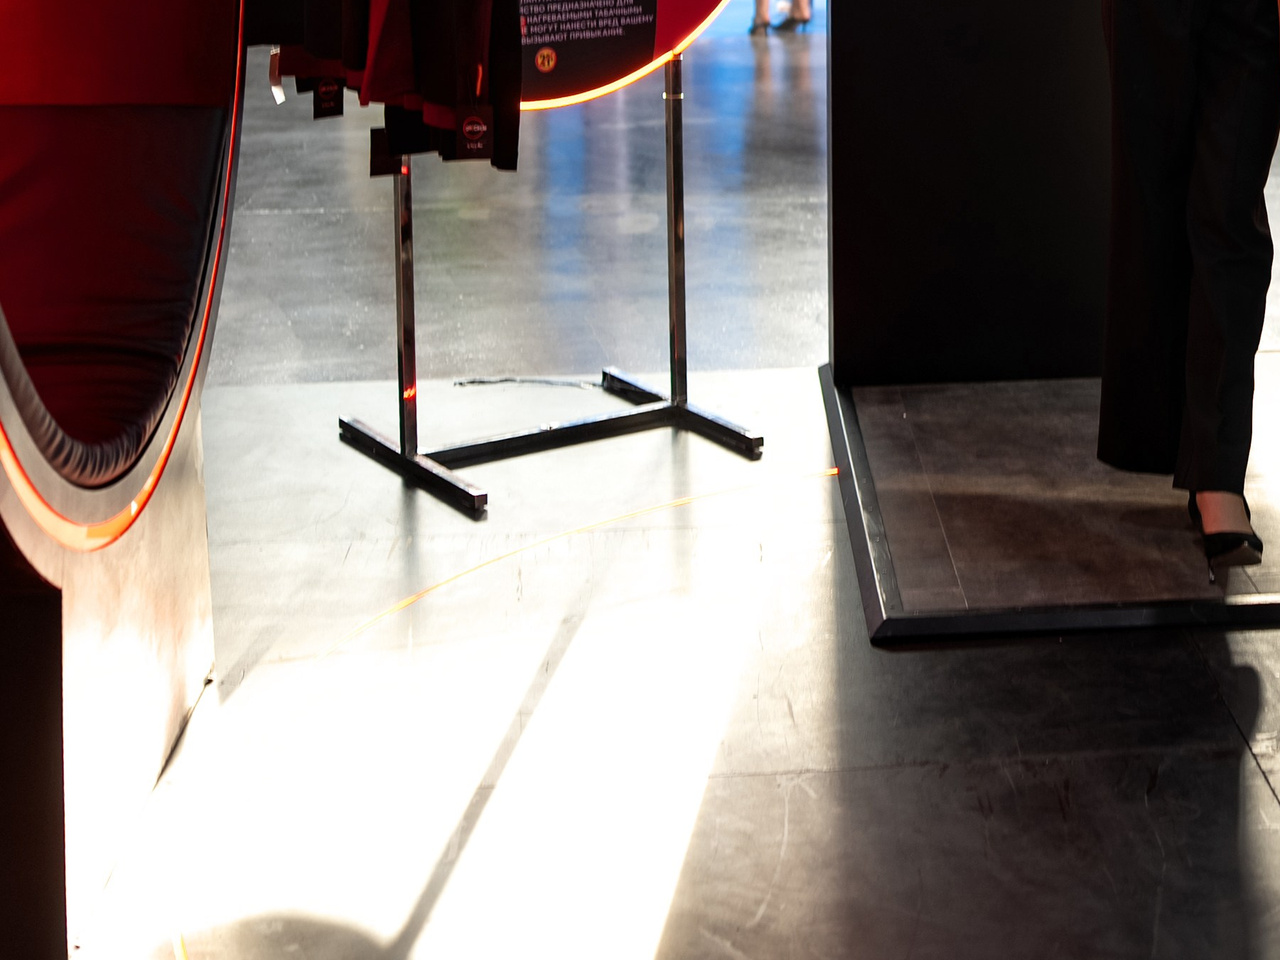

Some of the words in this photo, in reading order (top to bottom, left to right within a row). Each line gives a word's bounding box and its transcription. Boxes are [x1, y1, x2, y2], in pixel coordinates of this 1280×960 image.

[527, 10, 592, 24] НАГРЕВАЕМЫМИ
[595, 5, 642, 17] ТАБАЧНЫМИ
[530, 23, 558, 35] МОГУТ
[560, 19, 597, 31] НАНЕСТИ
[599, 17, 619, 28] ВРЕД
[621, 14, 654, 26] ВАШЕМУ
